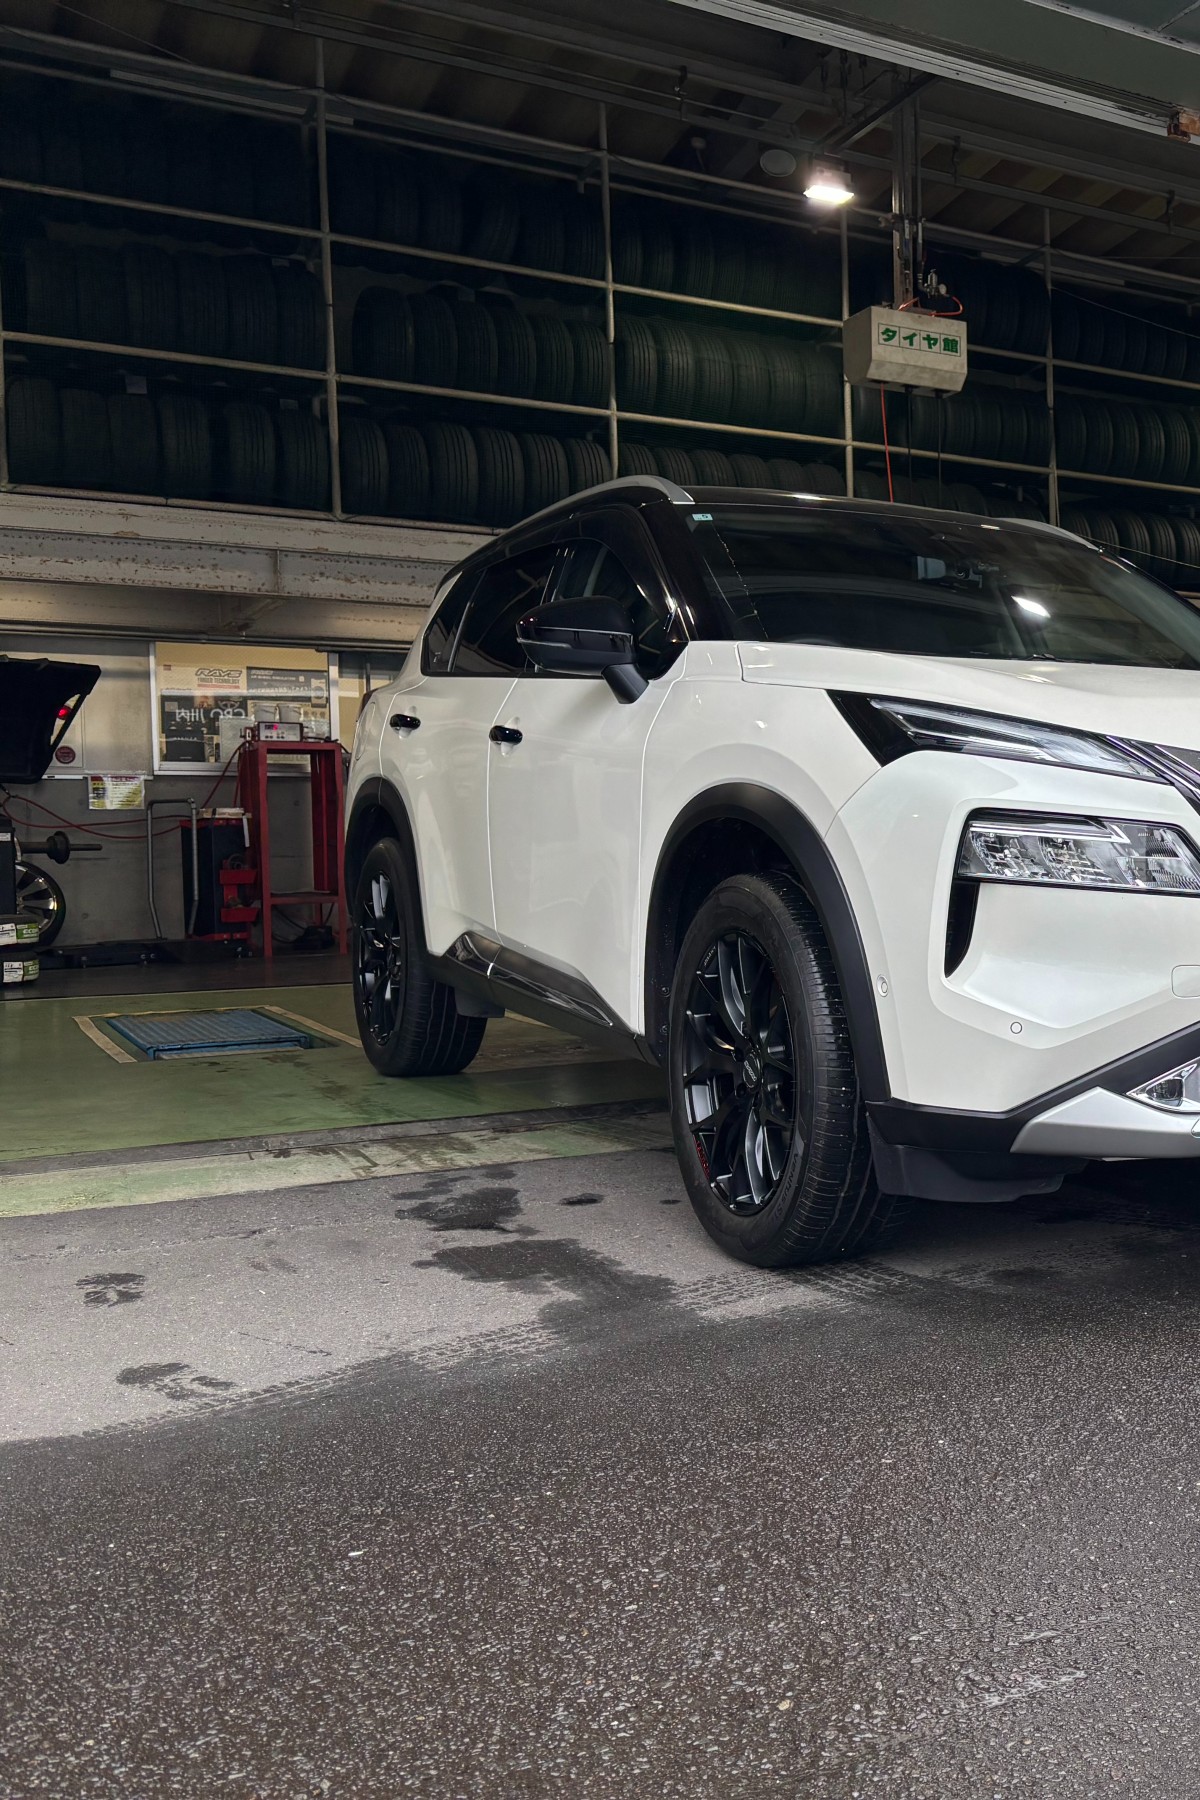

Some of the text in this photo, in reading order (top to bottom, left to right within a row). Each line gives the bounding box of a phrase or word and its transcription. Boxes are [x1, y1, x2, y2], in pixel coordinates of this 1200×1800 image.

[881, 327, 959, 354] タイヤ館
[195, 667, 243, 678] RAYS
